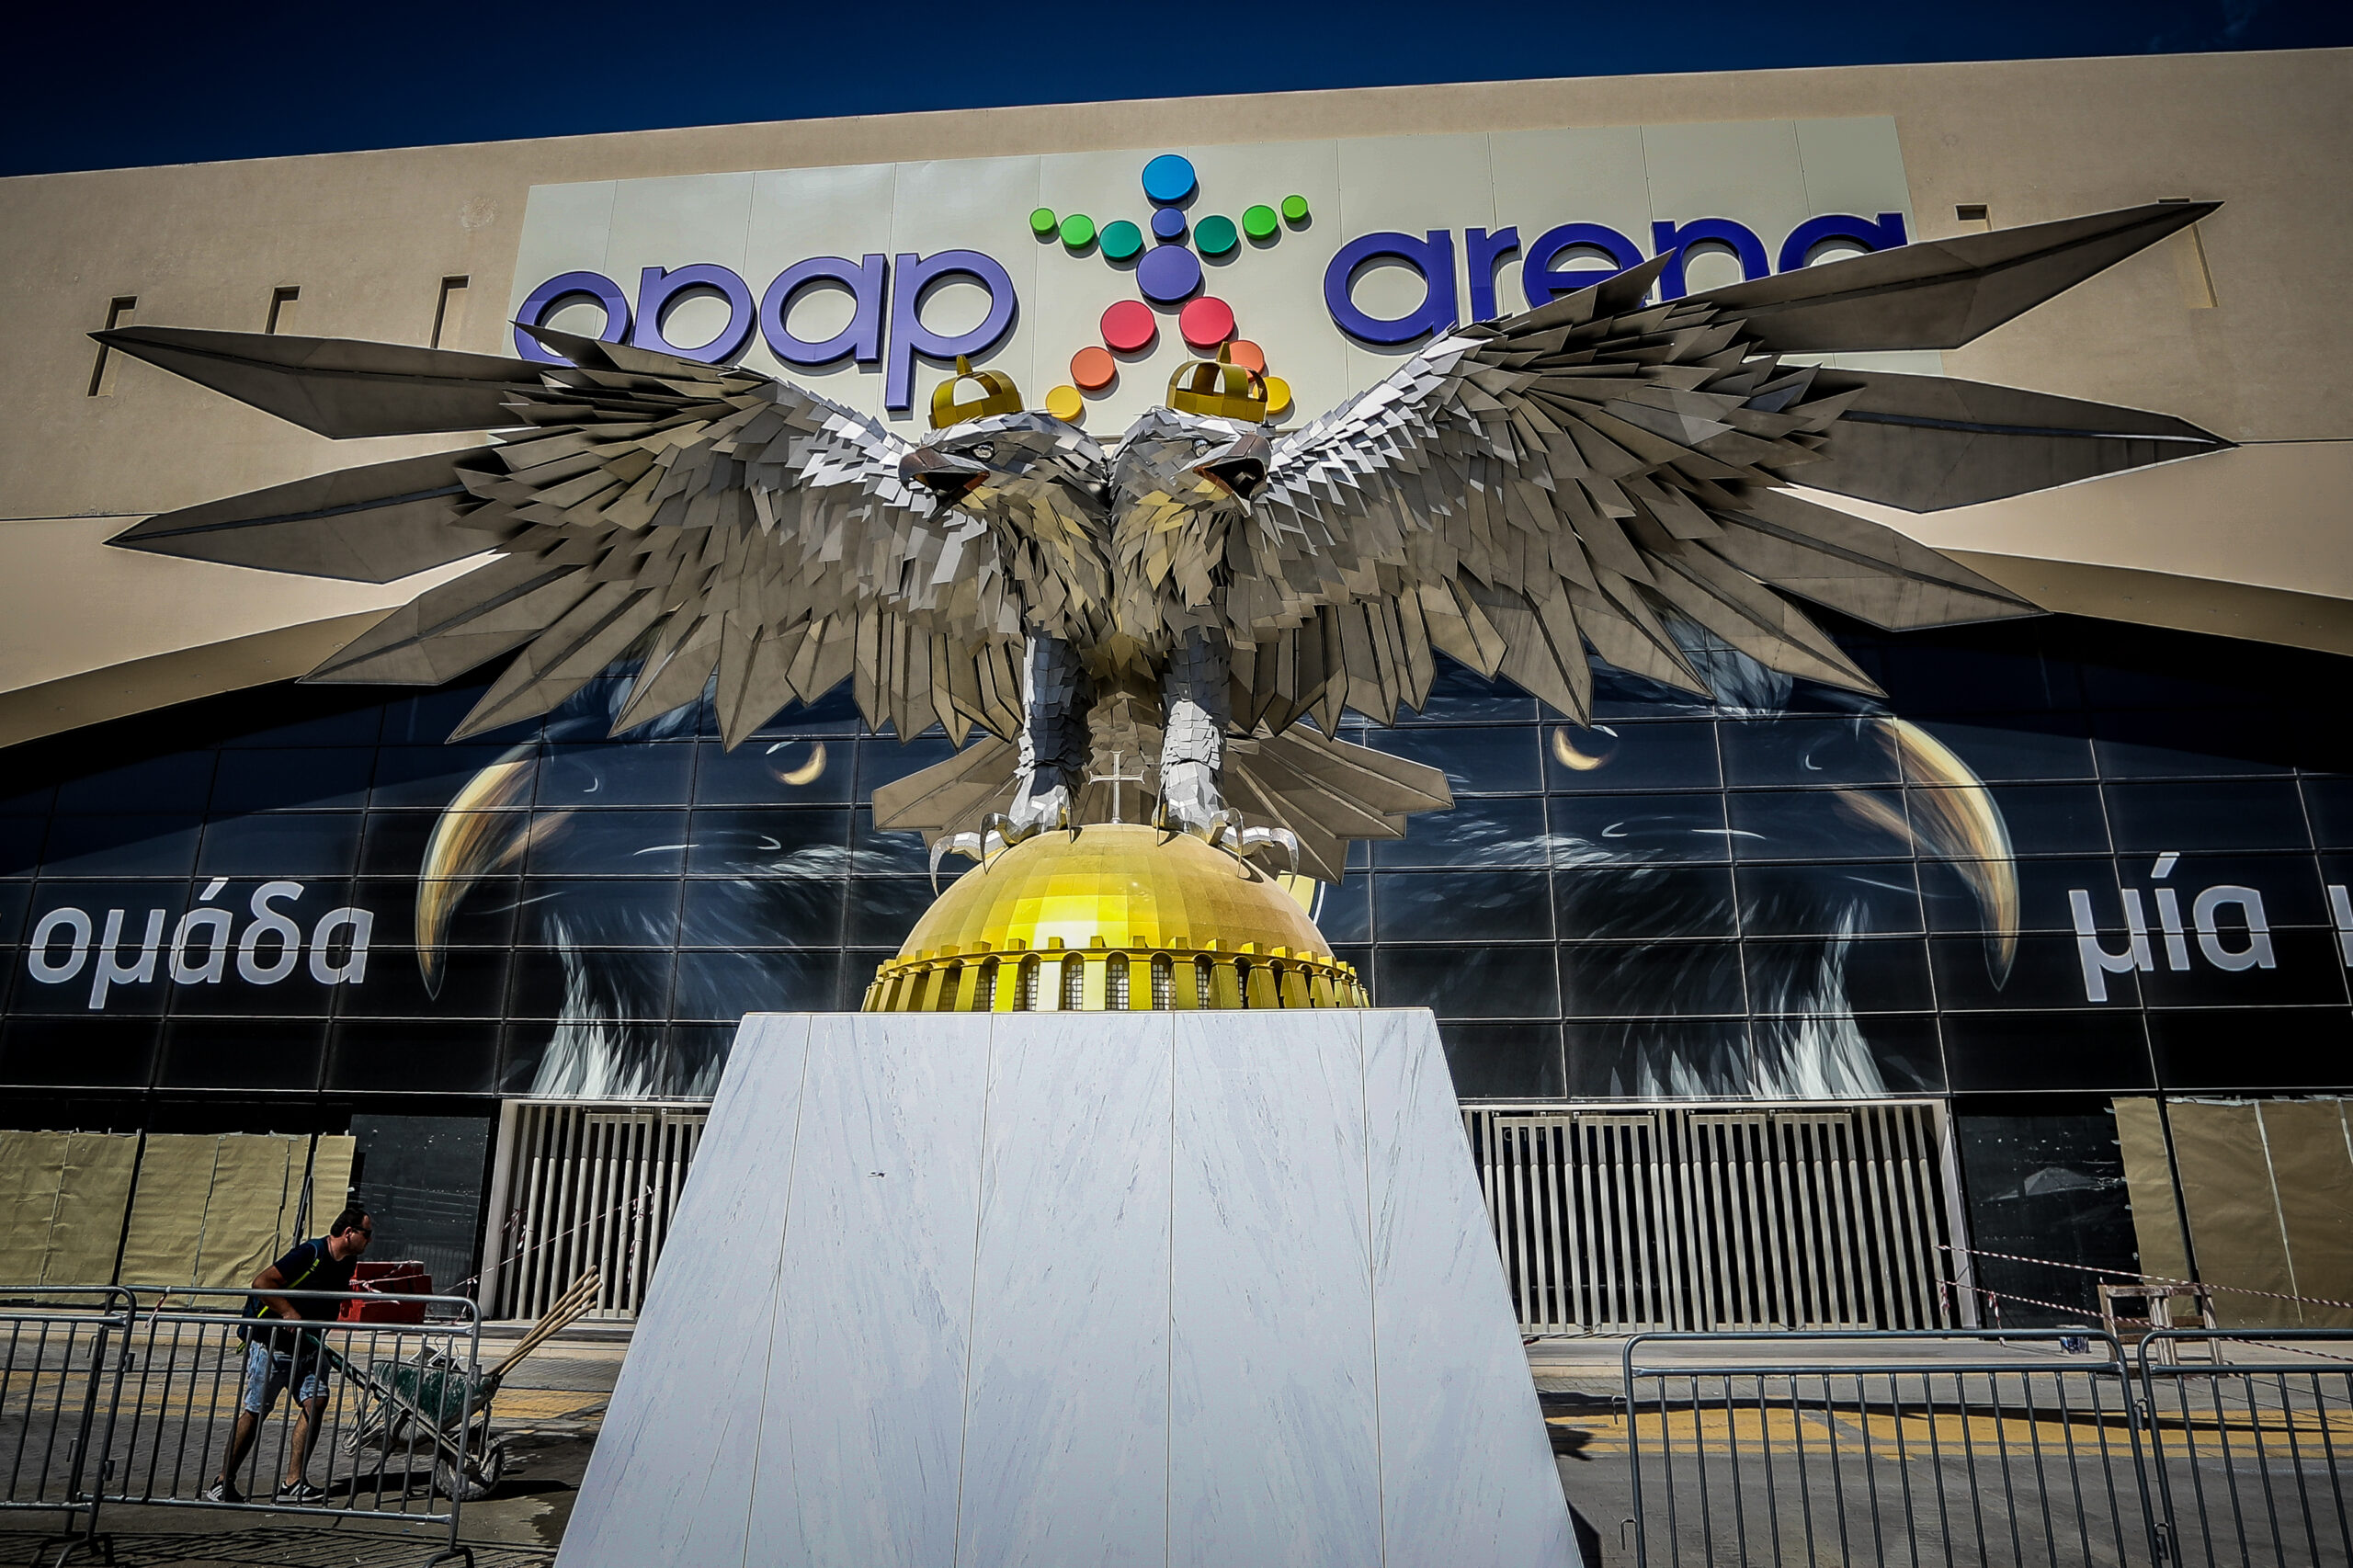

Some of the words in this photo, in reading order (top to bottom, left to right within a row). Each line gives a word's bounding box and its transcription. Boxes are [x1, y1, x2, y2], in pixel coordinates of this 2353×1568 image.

[514, 249, 1017, 411] opap
[28, 878, 374, 1009] ομάδα
[2068, 852, 2277, 1002] μία
